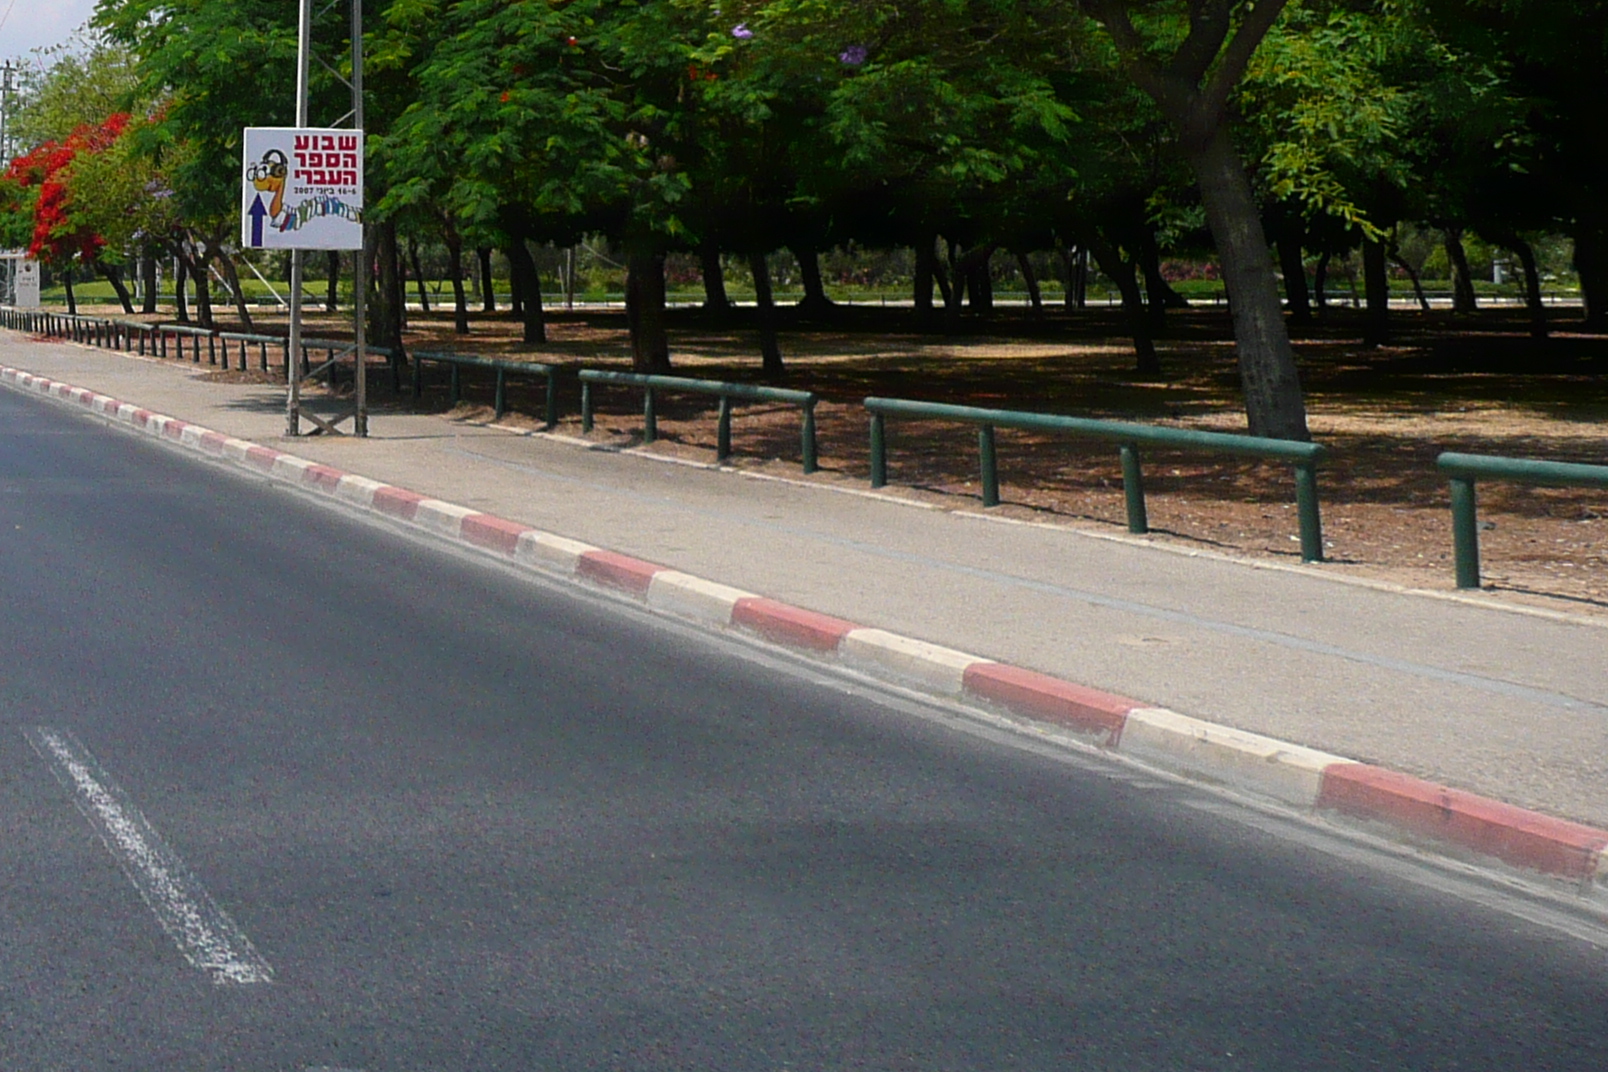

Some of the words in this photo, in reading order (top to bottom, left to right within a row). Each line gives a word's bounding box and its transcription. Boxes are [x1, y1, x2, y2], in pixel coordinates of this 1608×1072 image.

[294, 135, 357, 150] שבוע
[294, 152, 357, 168] הספר
[294, 170, 357, 185] העברי
[294, 186, 314, 195] 2007
